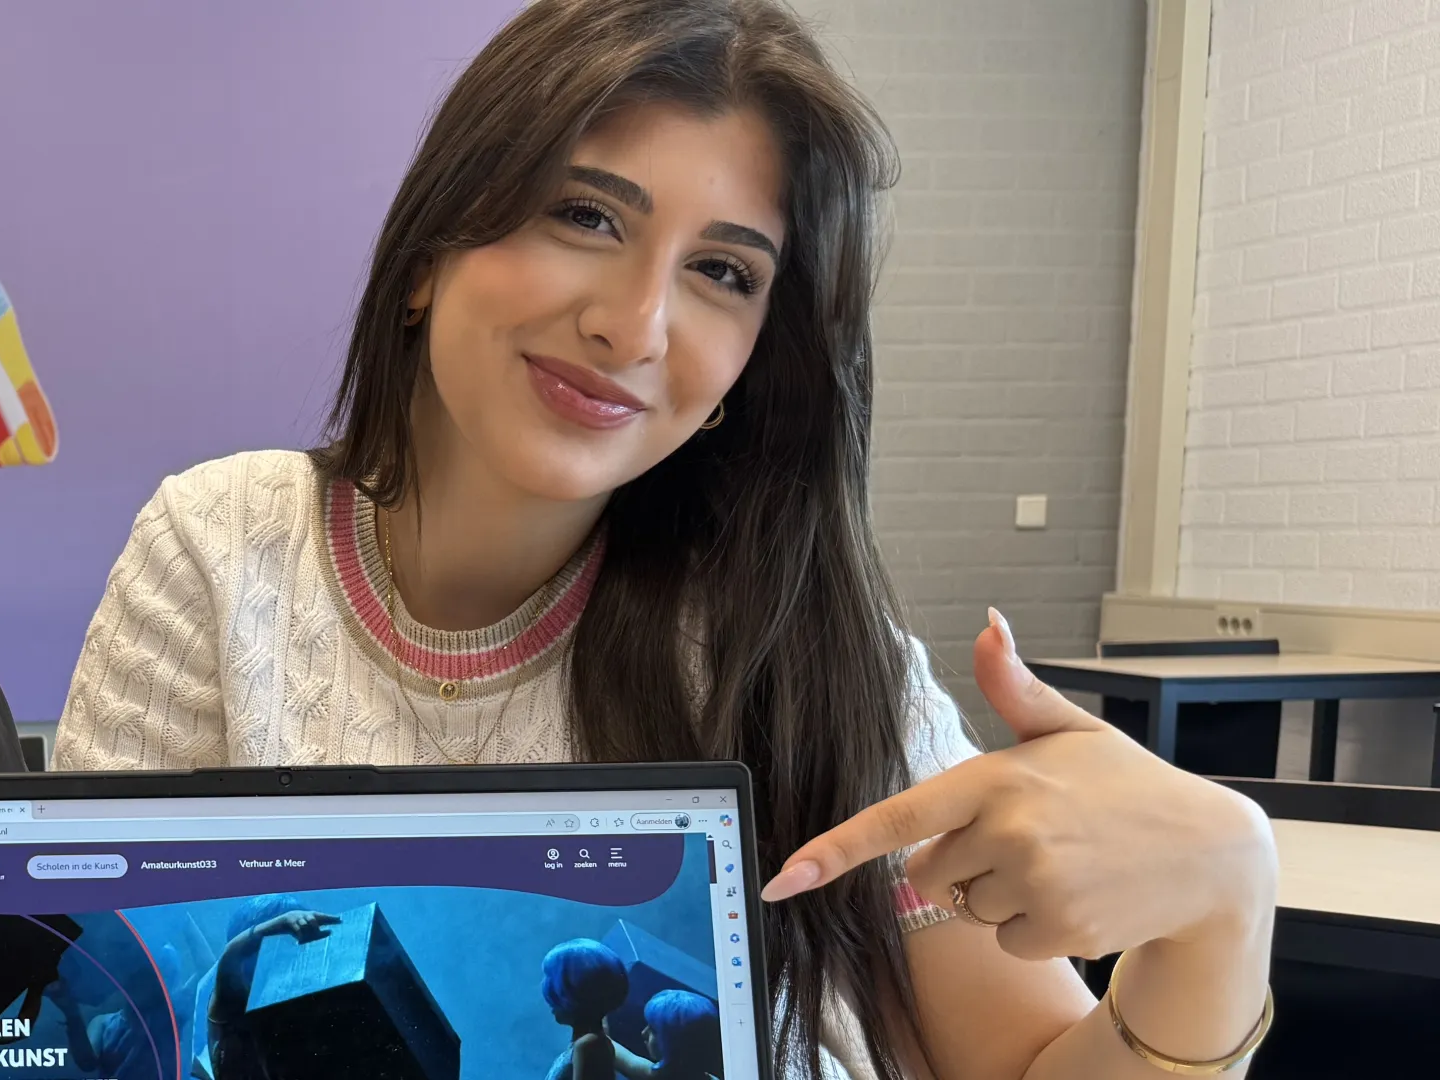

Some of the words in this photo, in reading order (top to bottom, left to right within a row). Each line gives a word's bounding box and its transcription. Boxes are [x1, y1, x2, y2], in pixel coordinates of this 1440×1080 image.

[36, 862, 70, 871] Scholen
[71, 862, 79, 870] in
[81, 861, 92, 870] de
[94, 861, 119, 870] Kunst
[140, 860, 217, 870] Amateurkunst033
[239, 859, 273, 868] Verhuur
[274, 859, 282, 868] &
[283, 858, 306, 867] Meer
